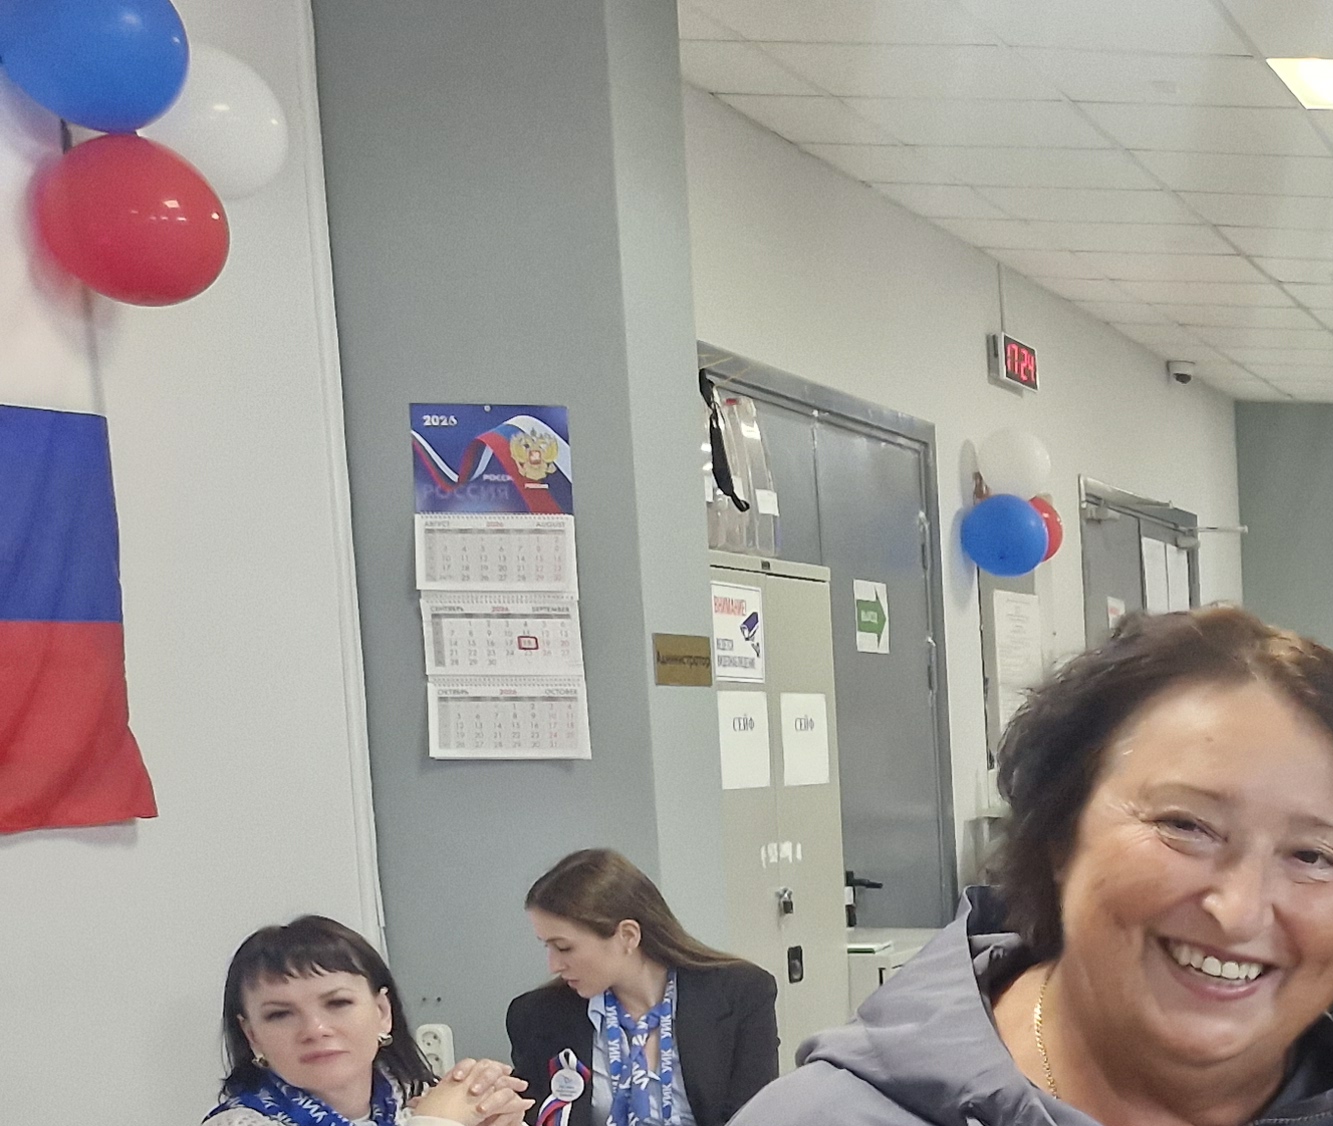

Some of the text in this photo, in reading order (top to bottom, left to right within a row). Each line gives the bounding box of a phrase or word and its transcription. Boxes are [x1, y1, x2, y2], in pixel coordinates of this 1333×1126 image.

[422, 415, 458, 426] 2026
[732, 713, 755, 732] СЕЙФ
[794, 714, 815, 732] СЕЙФ
[661, 1015, 672, 1038] УИК
[661, 1049, 673, 1073] УИК
